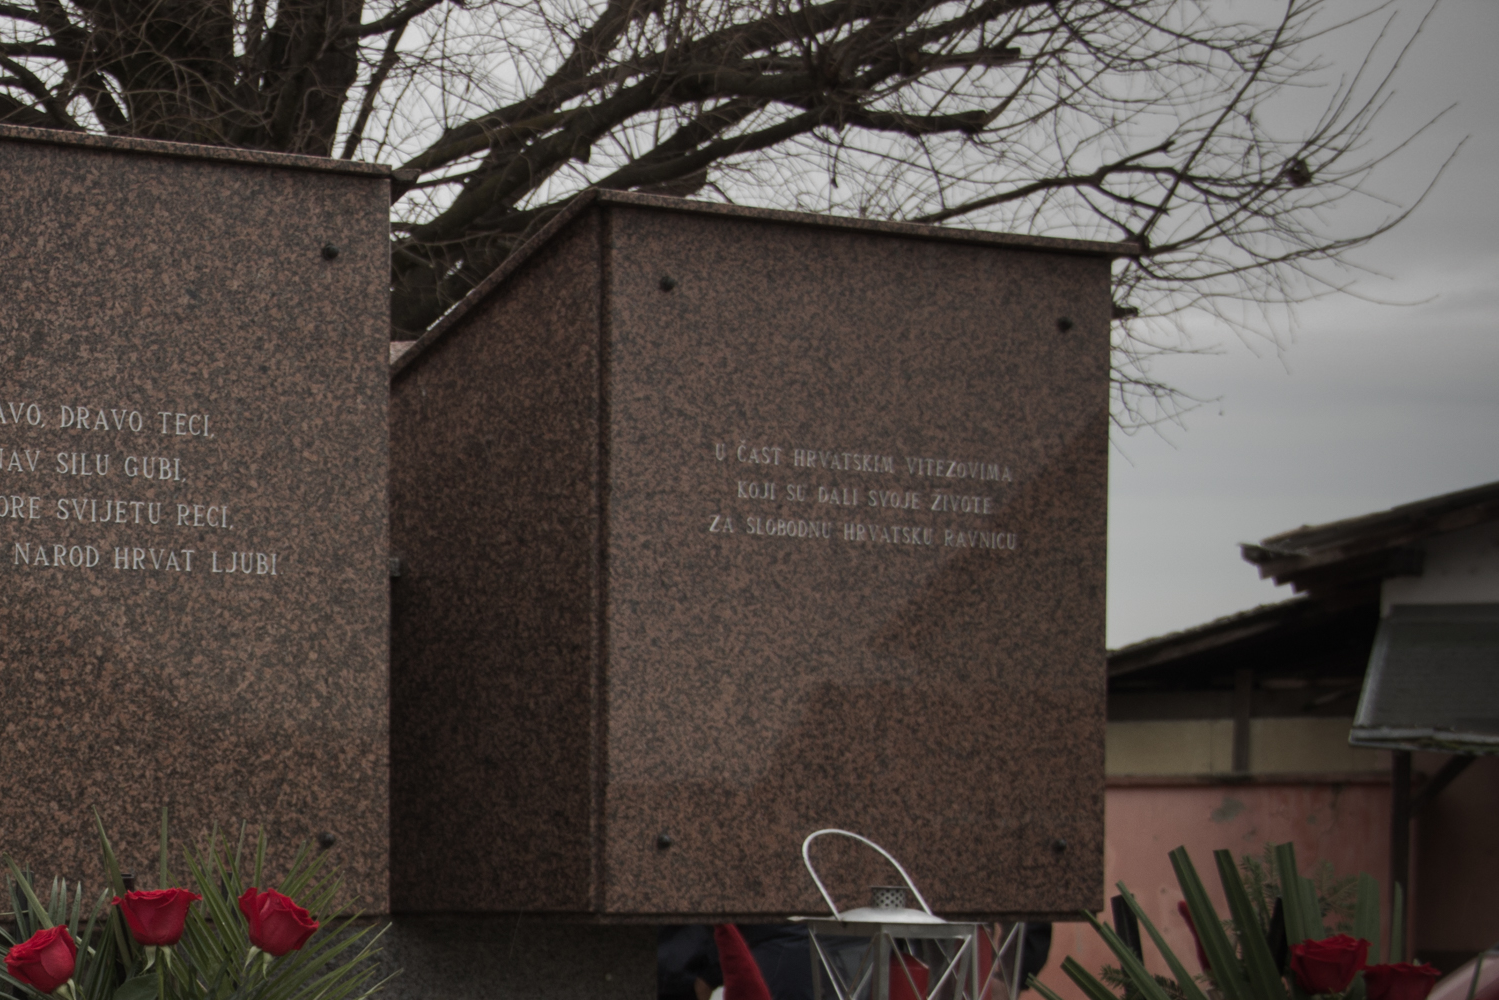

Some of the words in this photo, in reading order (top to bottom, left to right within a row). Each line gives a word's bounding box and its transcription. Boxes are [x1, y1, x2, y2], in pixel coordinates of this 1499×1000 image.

[60, 405, 143, 432] DRAVO
[158, 411, 215, 439] TECI,
[56, 452, 110, 476] SILU
[124, 456, 187, 482] GUBI,
[715, 444, 726, 462] U
[736, 440, 782, 466] ČAST
[794, 450, 895, 474] HRVATSKIM
[905, 457, 1013, 483] VITEZOVIMA
[56, 498, 162, 525] SVIJETU
[176, 503, 234, 529] RECI,
[737, 481, 776, 501] KOJI
[786, 484, 807, 503] SU
[818, 486, 858, 506] DALI
[868, 490, 921, 511] SVOJE
[931, 489, 993, 515] ŽIVOTE
[708, 513, 735, 534] ZA
[746, 517, 832, 539] SLOBODNU
[843, 523, 934, 546] HRVATSKU
[944, 529, 1017, 551] RAVNICU
[14, 542, 100, 568] NAROD
[113, 547, 196, 572] HRVAT
